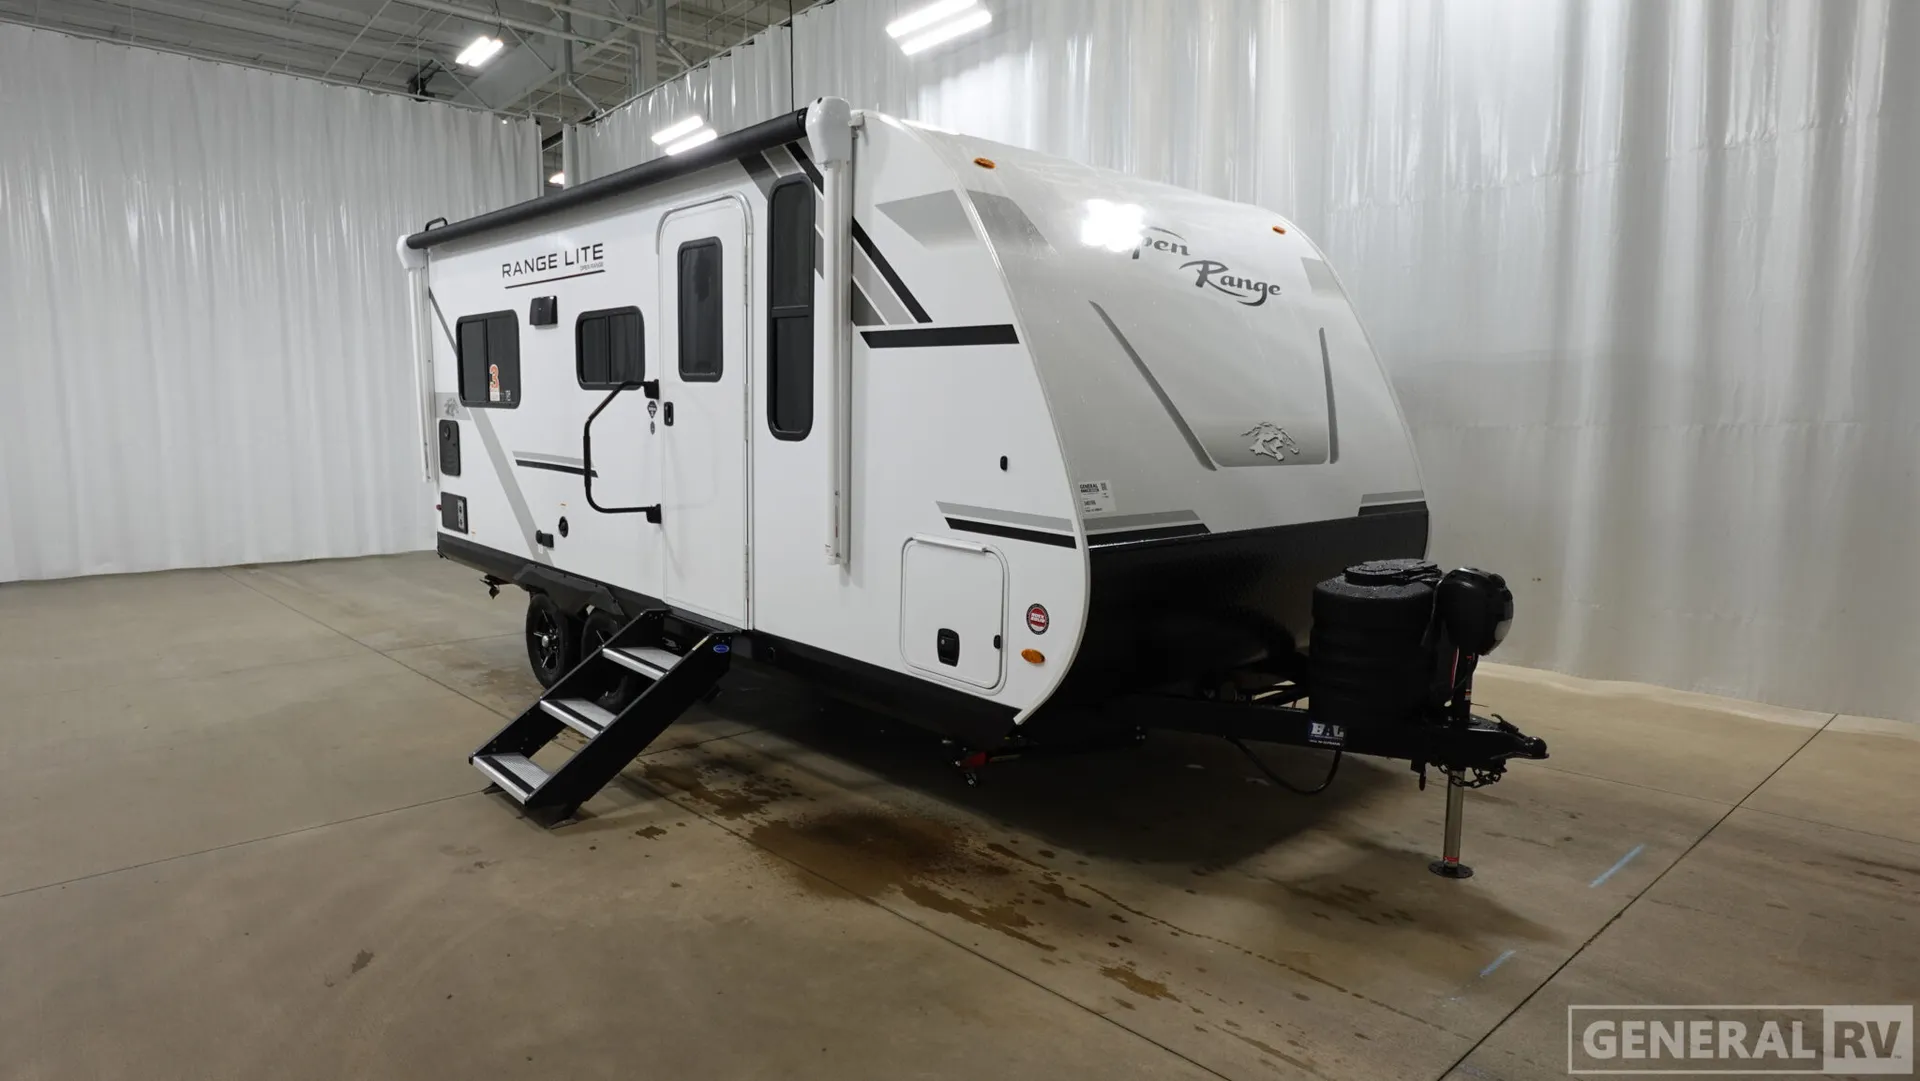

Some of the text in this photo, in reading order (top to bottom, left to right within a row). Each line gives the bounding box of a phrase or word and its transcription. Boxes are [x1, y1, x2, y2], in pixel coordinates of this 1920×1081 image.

[1125, 226, 1190, 260] pen
[502, 243, 604, 278] RANGE LITE
[1179, 260, 1282, 307] Range
[489, 364, 499, 389] 3
[1310, 722, 1344, 737] BL
